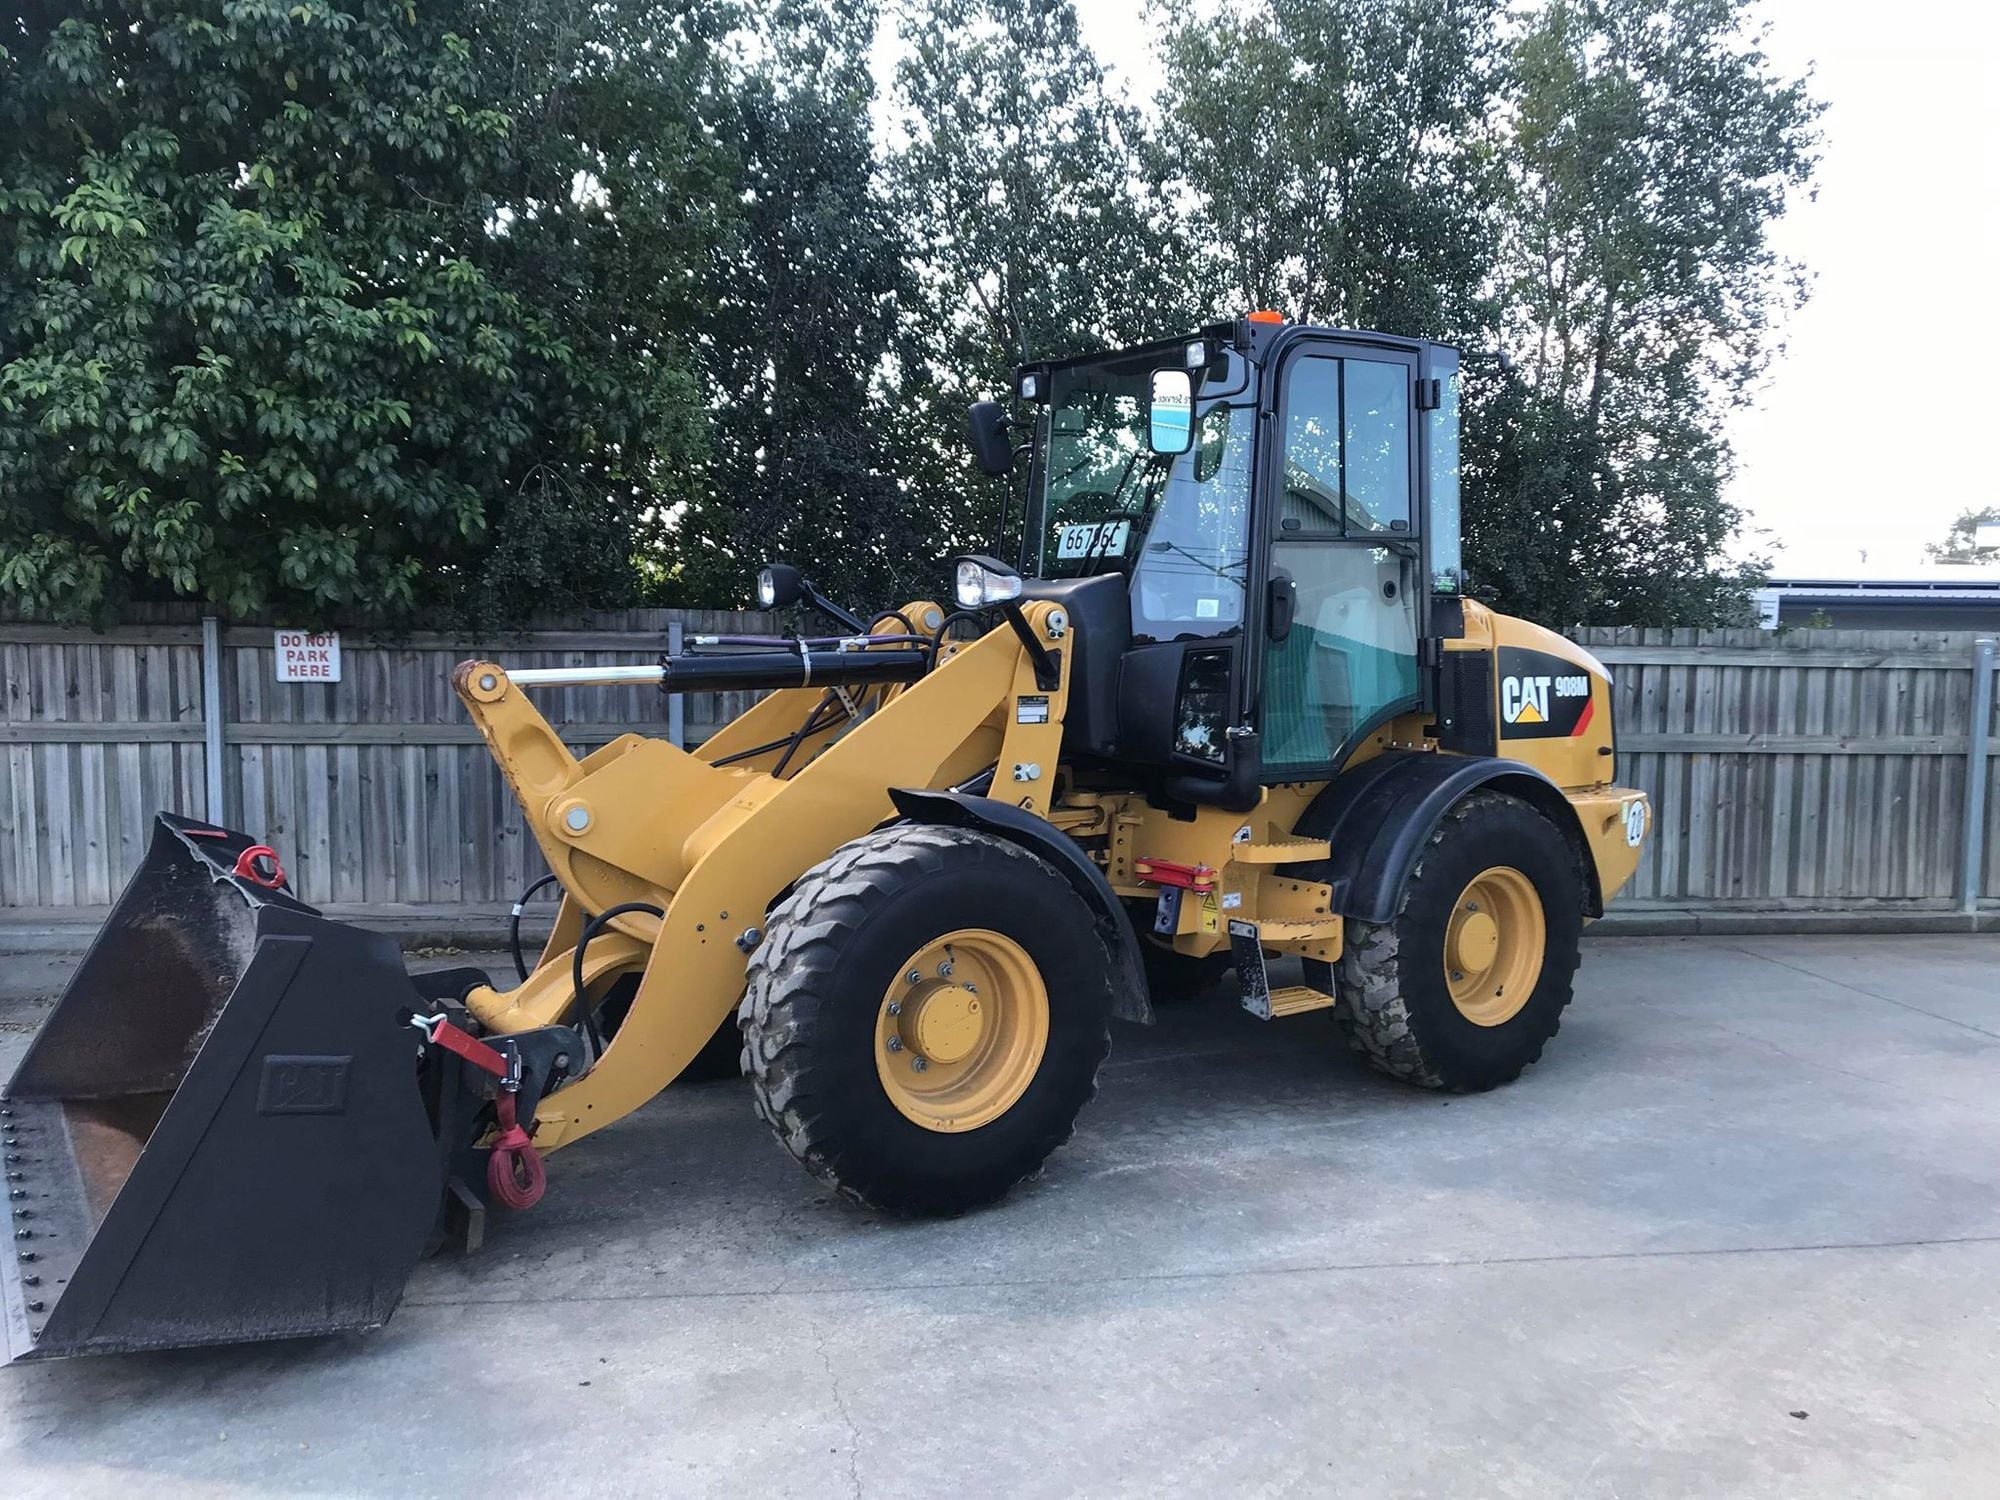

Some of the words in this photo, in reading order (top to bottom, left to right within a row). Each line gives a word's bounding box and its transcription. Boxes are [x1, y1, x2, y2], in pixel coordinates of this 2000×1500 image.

[280, 634, 301, 647] DO
[306, 634, 335, 647] NOT
[286, 650, 330, 662] PARK
[288, 665, 331, 677] HERE
[1502, 676, 1551, 724] CAT
[1555, 676, 1588, 697] 908M
